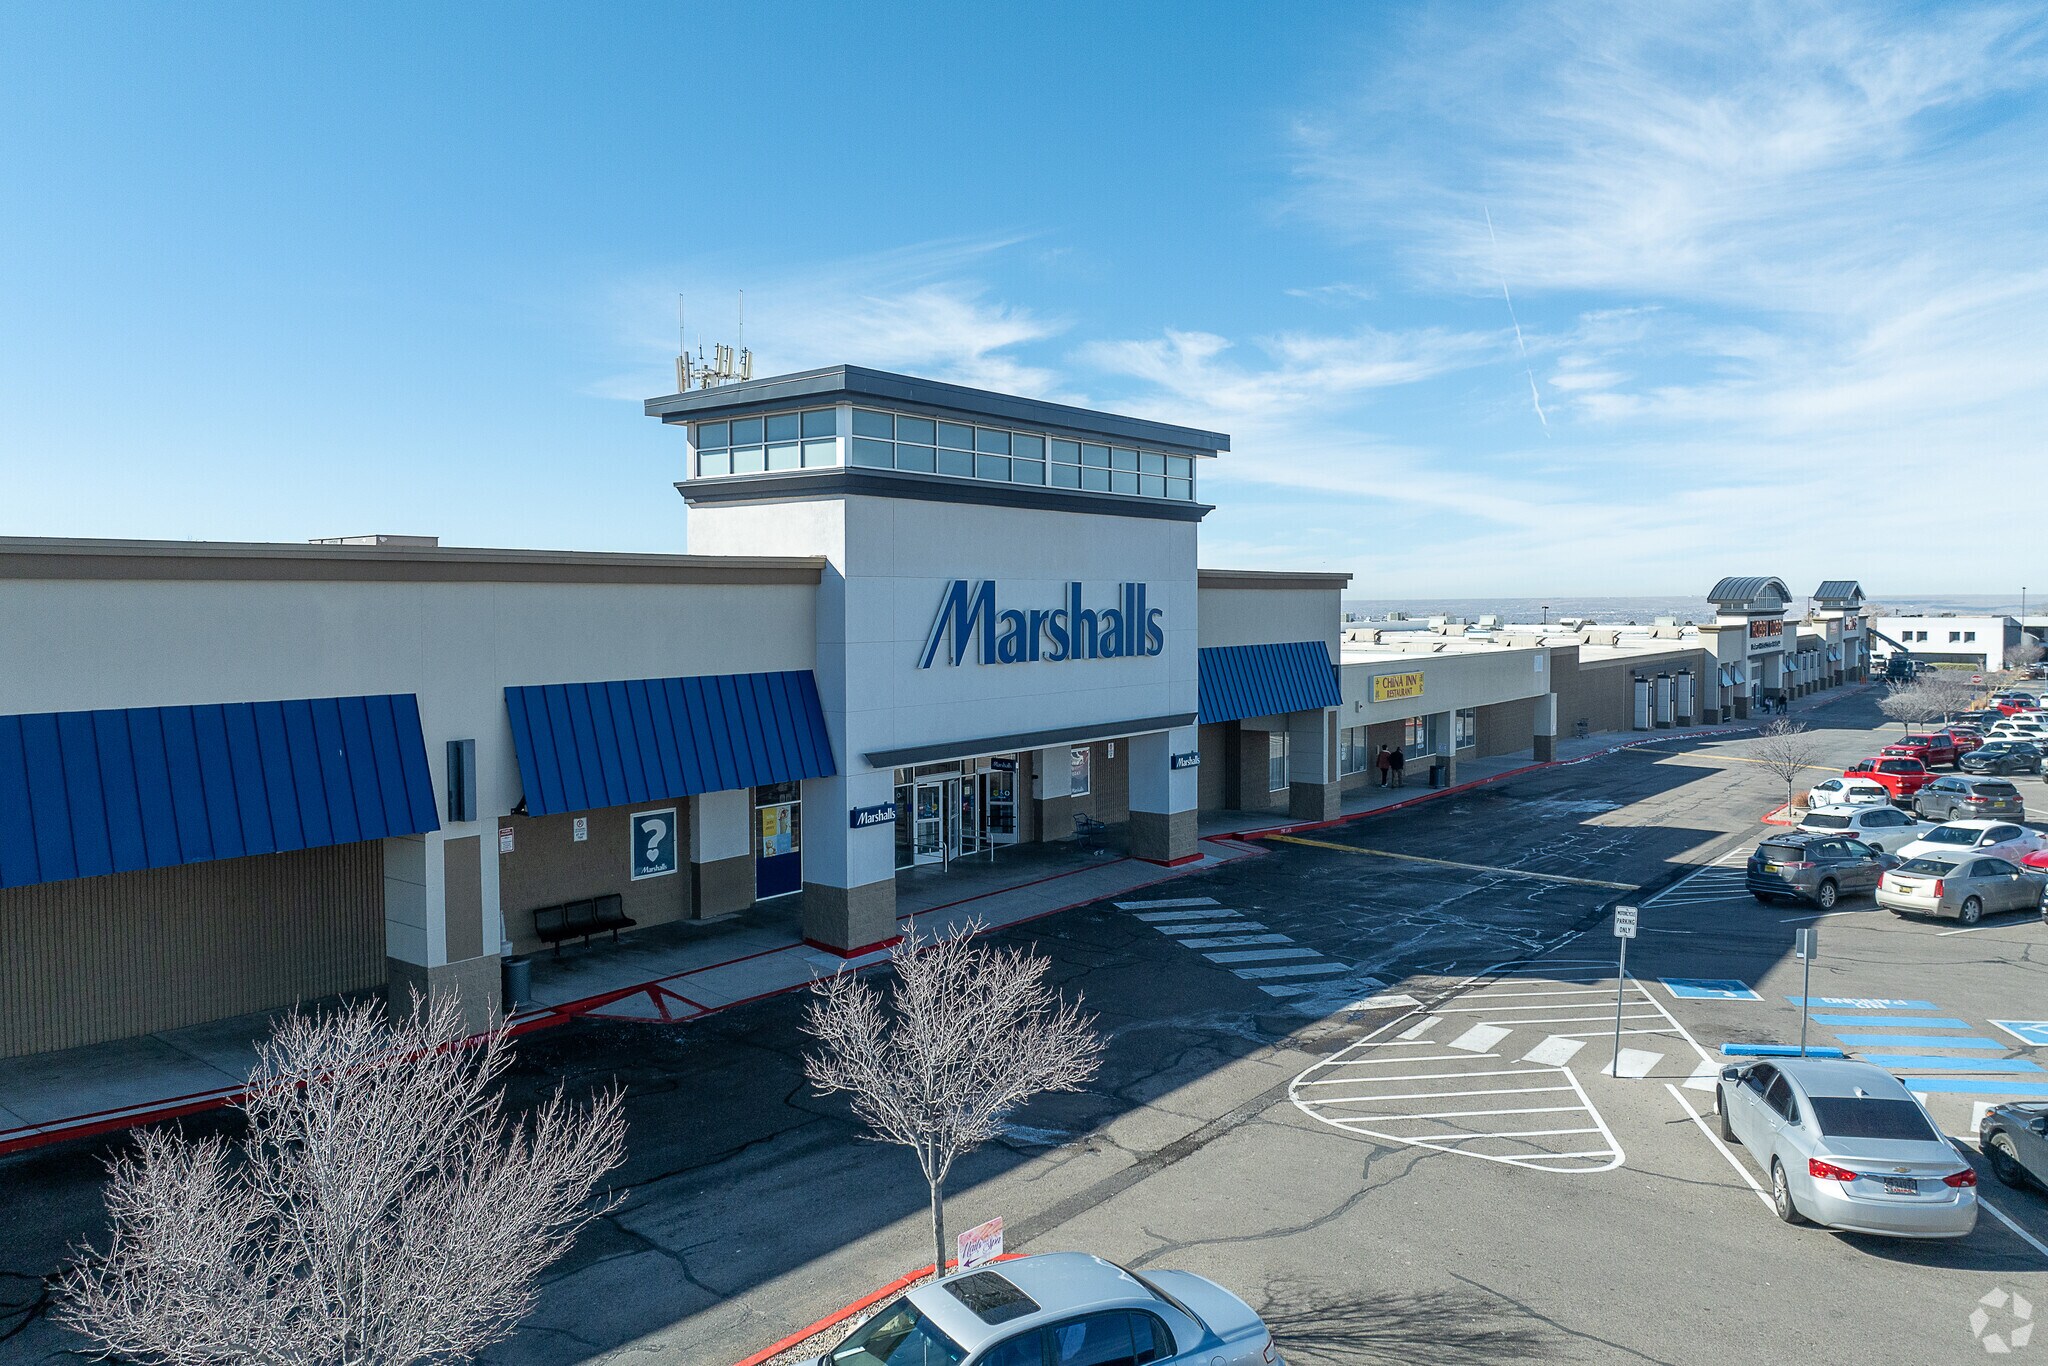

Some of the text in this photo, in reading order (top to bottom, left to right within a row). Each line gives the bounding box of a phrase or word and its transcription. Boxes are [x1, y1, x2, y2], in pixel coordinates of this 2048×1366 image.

[918, 579, 1164, 669] Marshalls
[1382, 675, 1404, 689] CHINA
[1405, 674, 1417, 687] INN
[1386, 687, 1413, 699] RESTAURANT
[1176, 755, 1200, 768] Marshalls
[857, 807, 896, 826] Marshalls
[640, 863, 668, 874] Marshalls
[1616, 917, 1636, 926] PARKING
[1619, 926, 1631, 934] ONLY
